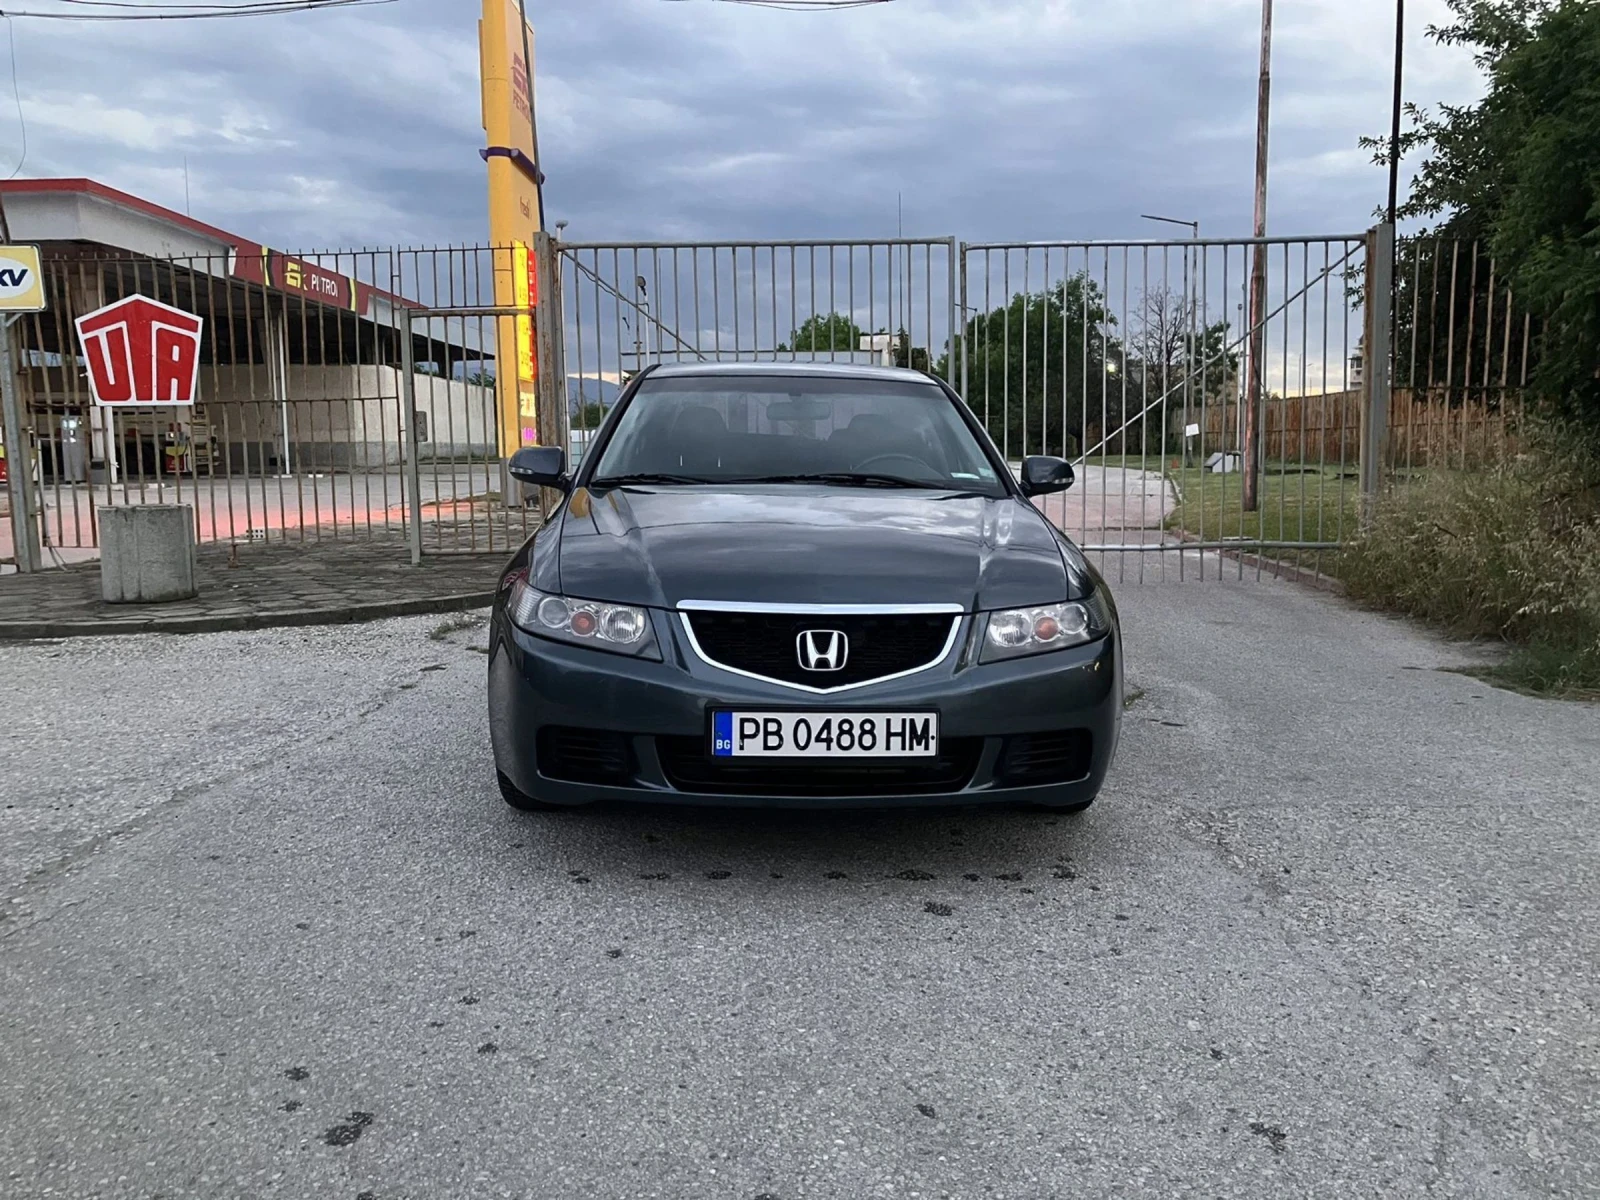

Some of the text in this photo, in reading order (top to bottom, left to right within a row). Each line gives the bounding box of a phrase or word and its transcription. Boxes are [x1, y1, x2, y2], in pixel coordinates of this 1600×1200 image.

[79, 298, 200, 402] UTA
[715, 739, 731, 750] BG
[738, 717, 931, 752] PB 0488 HM
